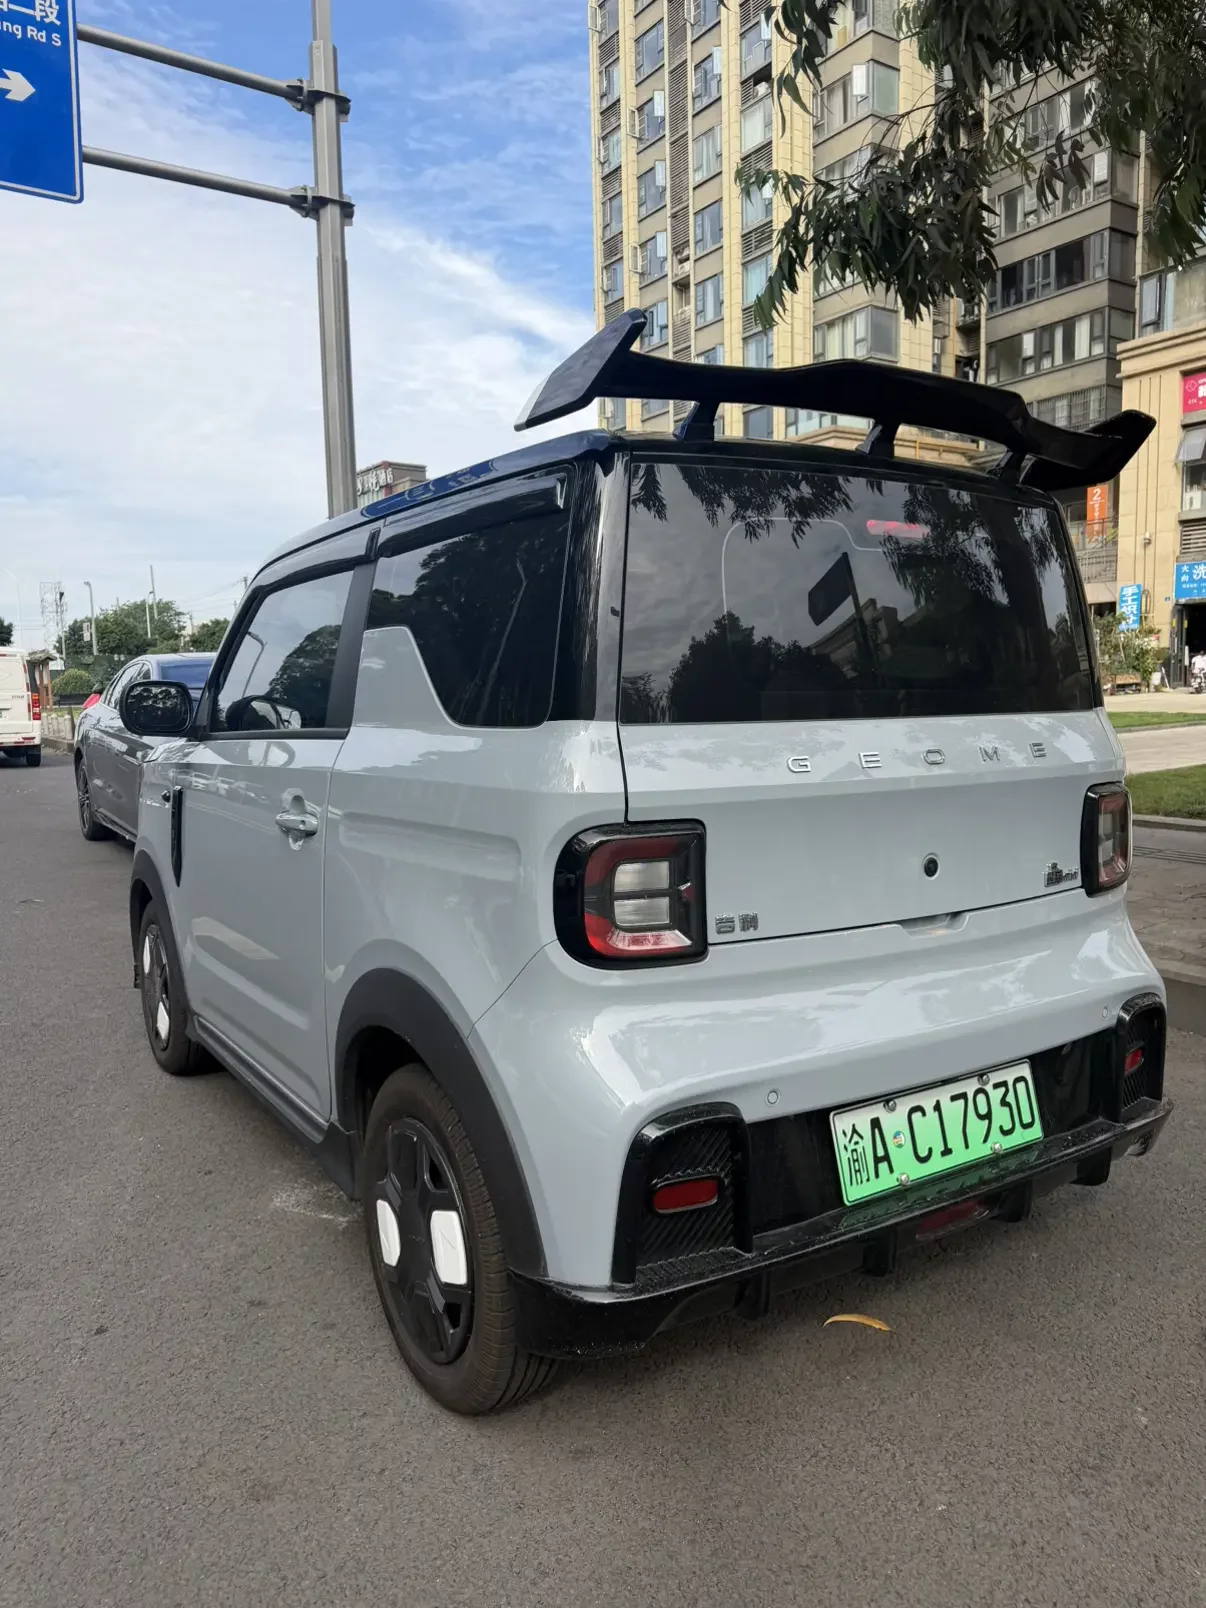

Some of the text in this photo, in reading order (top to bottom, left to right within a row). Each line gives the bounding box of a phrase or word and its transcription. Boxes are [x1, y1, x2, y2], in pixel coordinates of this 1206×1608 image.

[0, 0, 61, 25] 一段
[27, 25, 47, 43] Rd
[51, 33, 62, 46] S
[786, 741, 1048, 774] GEOME
